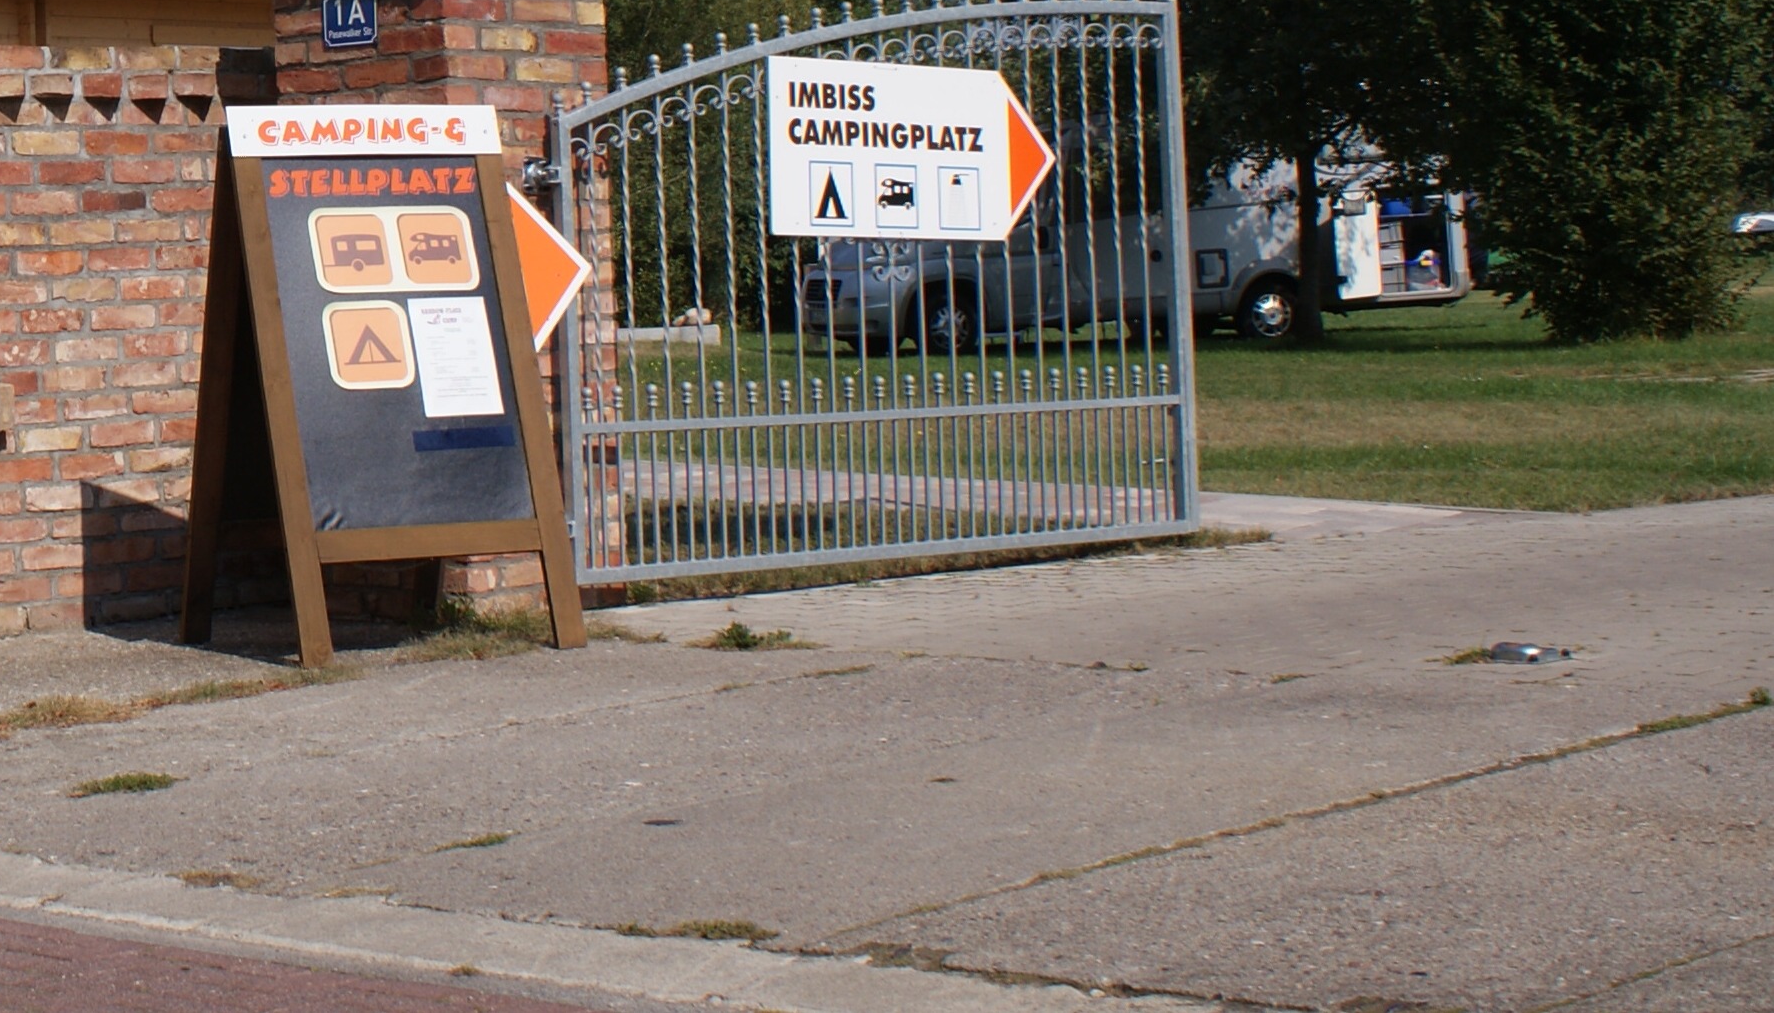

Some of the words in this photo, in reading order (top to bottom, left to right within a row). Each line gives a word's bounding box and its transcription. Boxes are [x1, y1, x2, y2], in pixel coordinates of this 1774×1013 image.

[787, 81, 876, 112] IMBISS
[787, 118, 984, 153] CAMPINGPLATZ
[268, 166, 476, 198] STELLPLATZ
